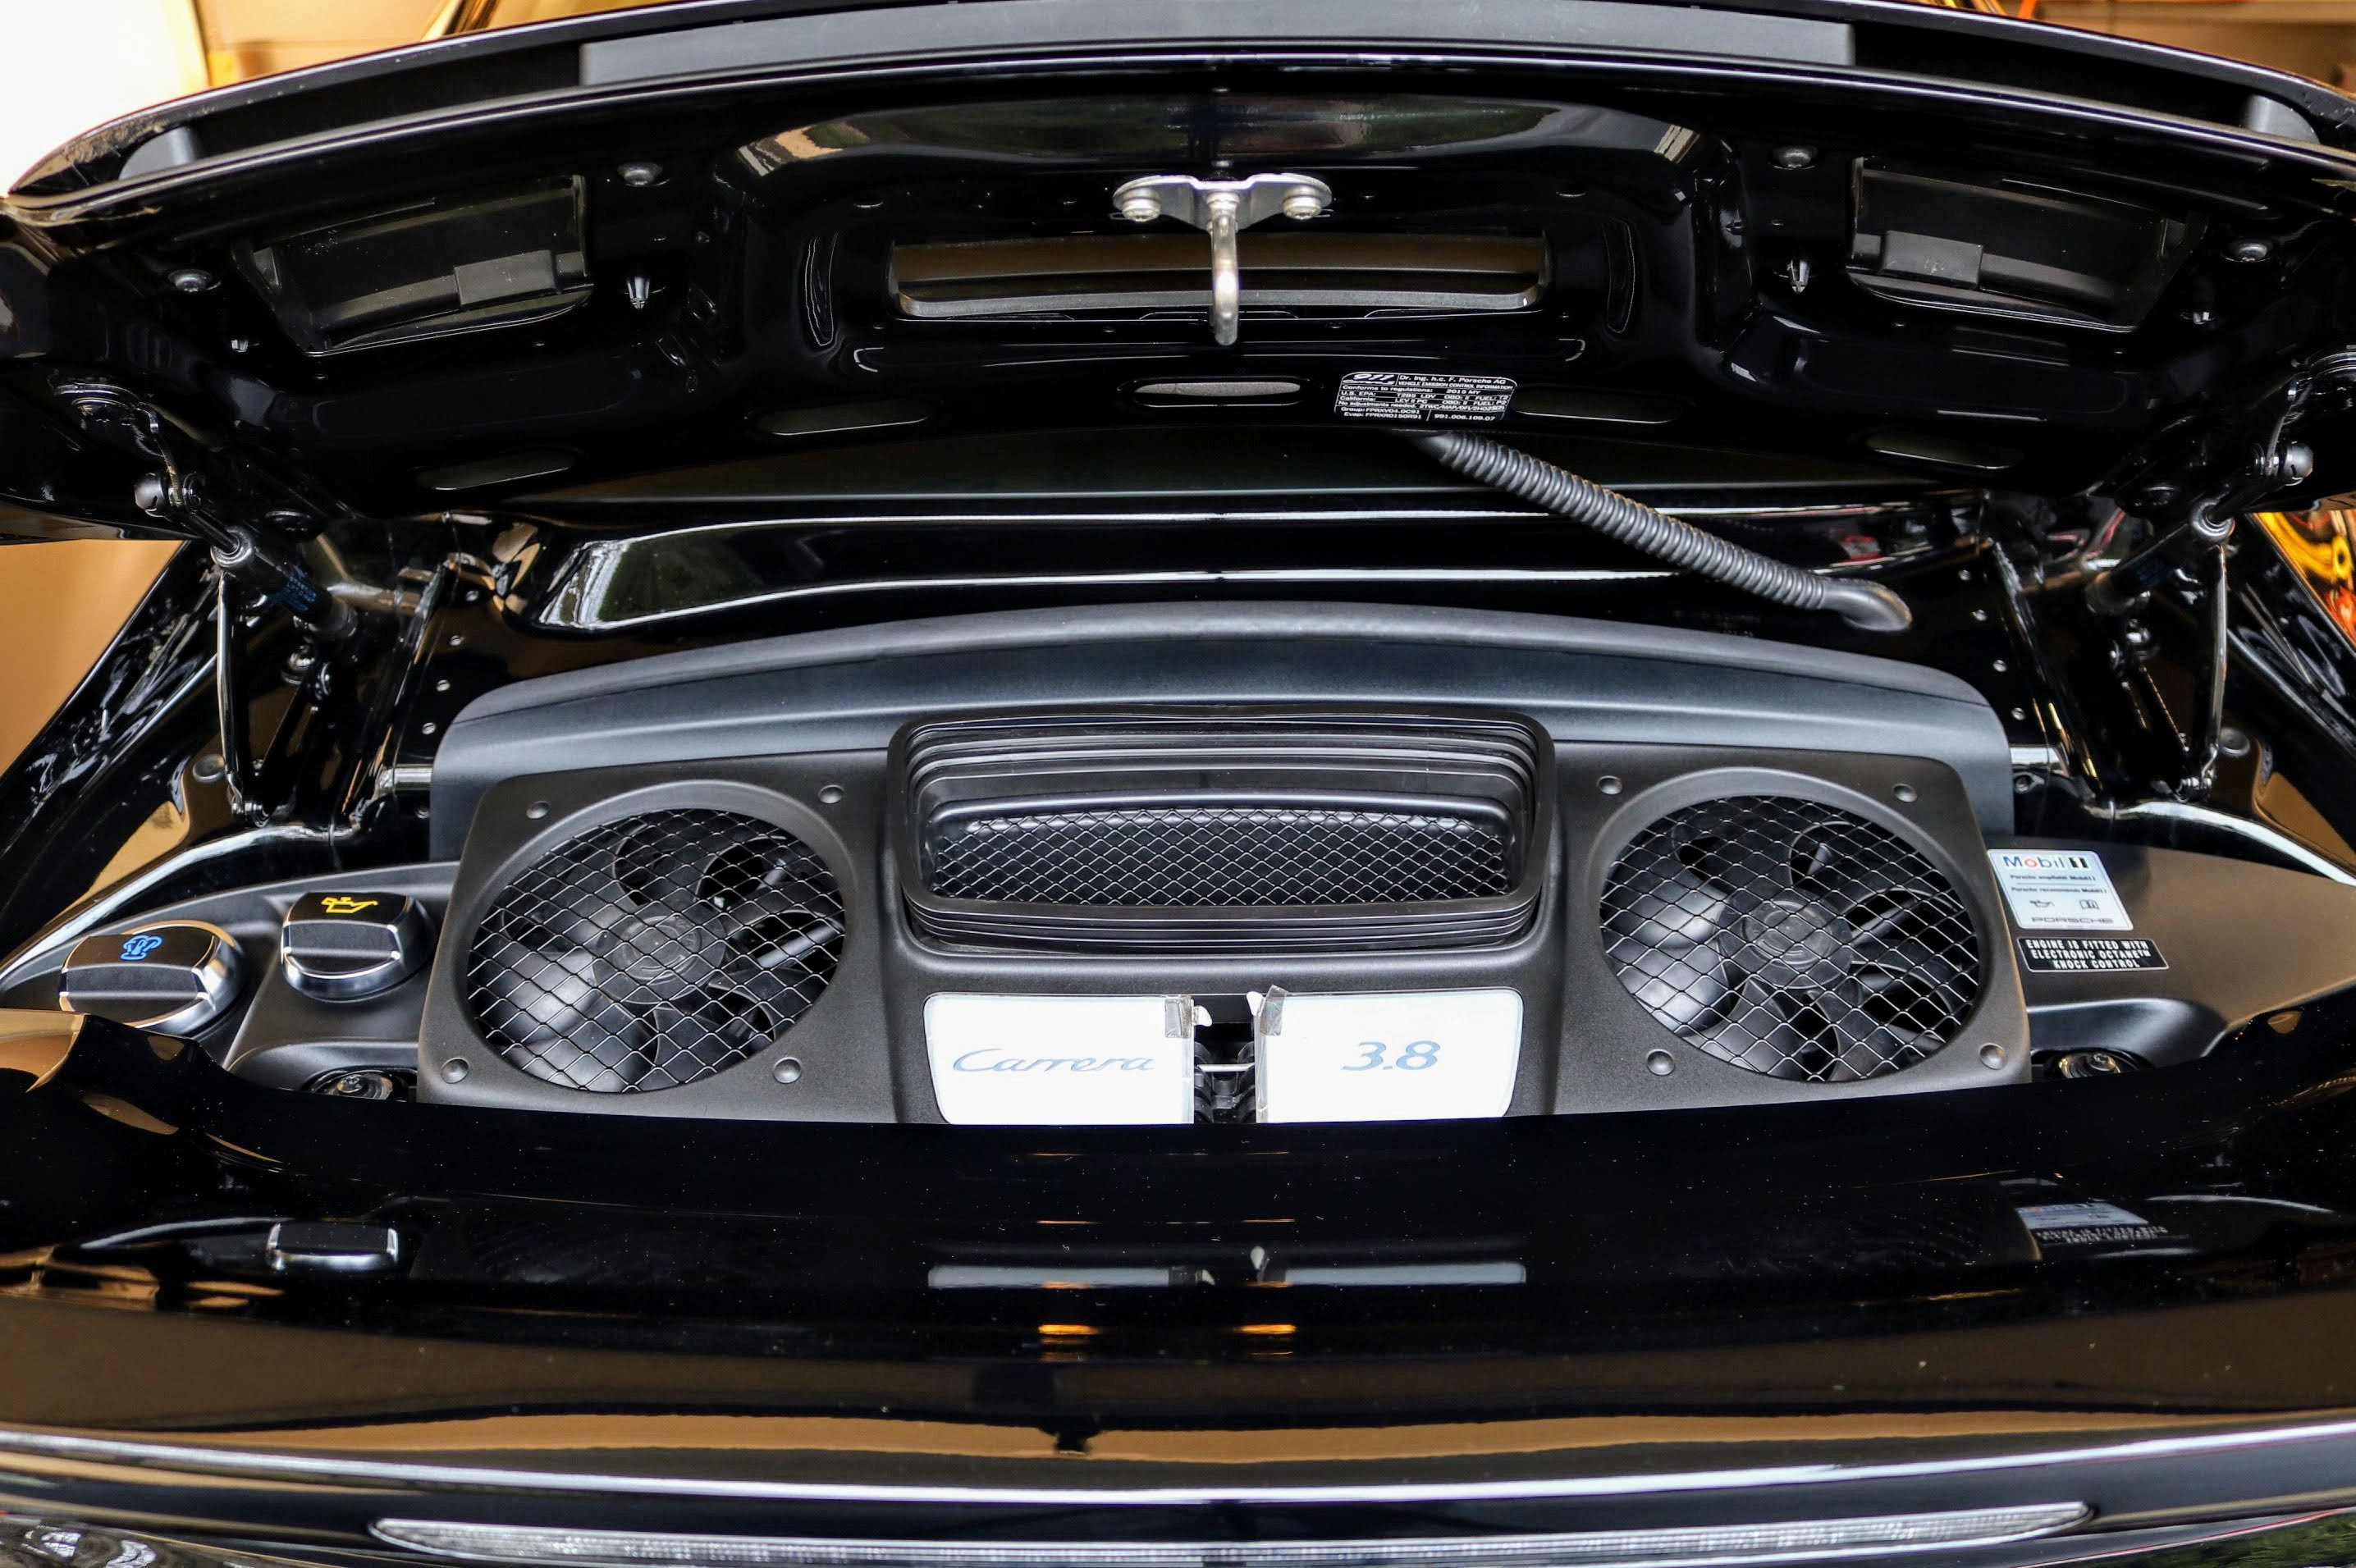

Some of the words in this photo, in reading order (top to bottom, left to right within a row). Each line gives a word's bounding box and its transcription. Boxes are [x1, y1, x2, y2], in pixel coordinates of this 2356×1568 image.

[2003, 856, 2066, 868] Mobil
[2025, 939, 2066, 949] ENGINE
[2068, 939, 2079, 949] IS
[2082, 940, 2119, 950] FITTED
[2120, 940, 2149, 949] WITH
[2030, 949, 2096, 960] ELECTRONIC
[2053, 960, 2088, 970] KNOCK
[2093, 959, 2140, 969] CONTROL
[1342, 1040, 1440, 1071] 3.8
[953, 1049, 1155, 1074] Carrera
